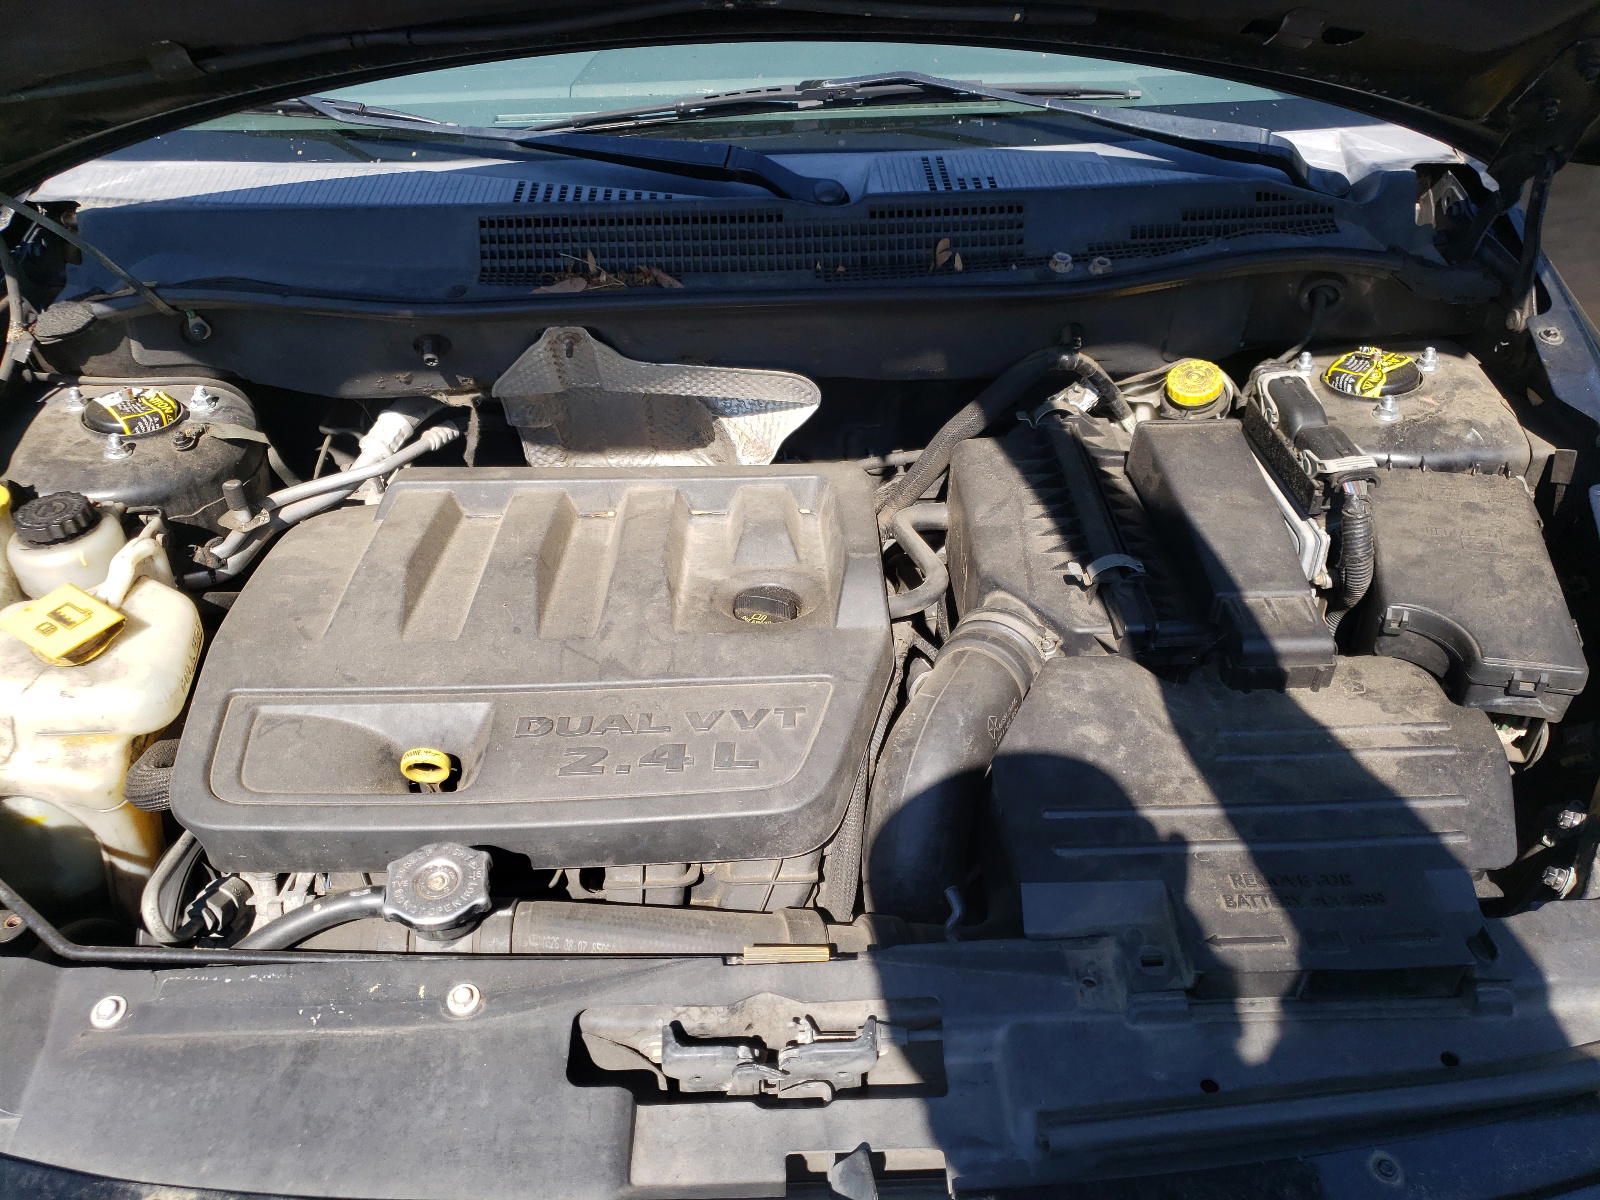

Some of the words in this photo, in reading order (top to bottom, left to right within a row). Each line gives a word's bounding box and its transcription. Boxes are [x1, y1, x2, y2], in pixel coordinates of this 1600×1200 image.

[512, 712, 671, 739] DUAL
[685, 706, 807, 732] VVT
[557, 743, 695, 777] 2.4
[713, 742, 760, 771] L
